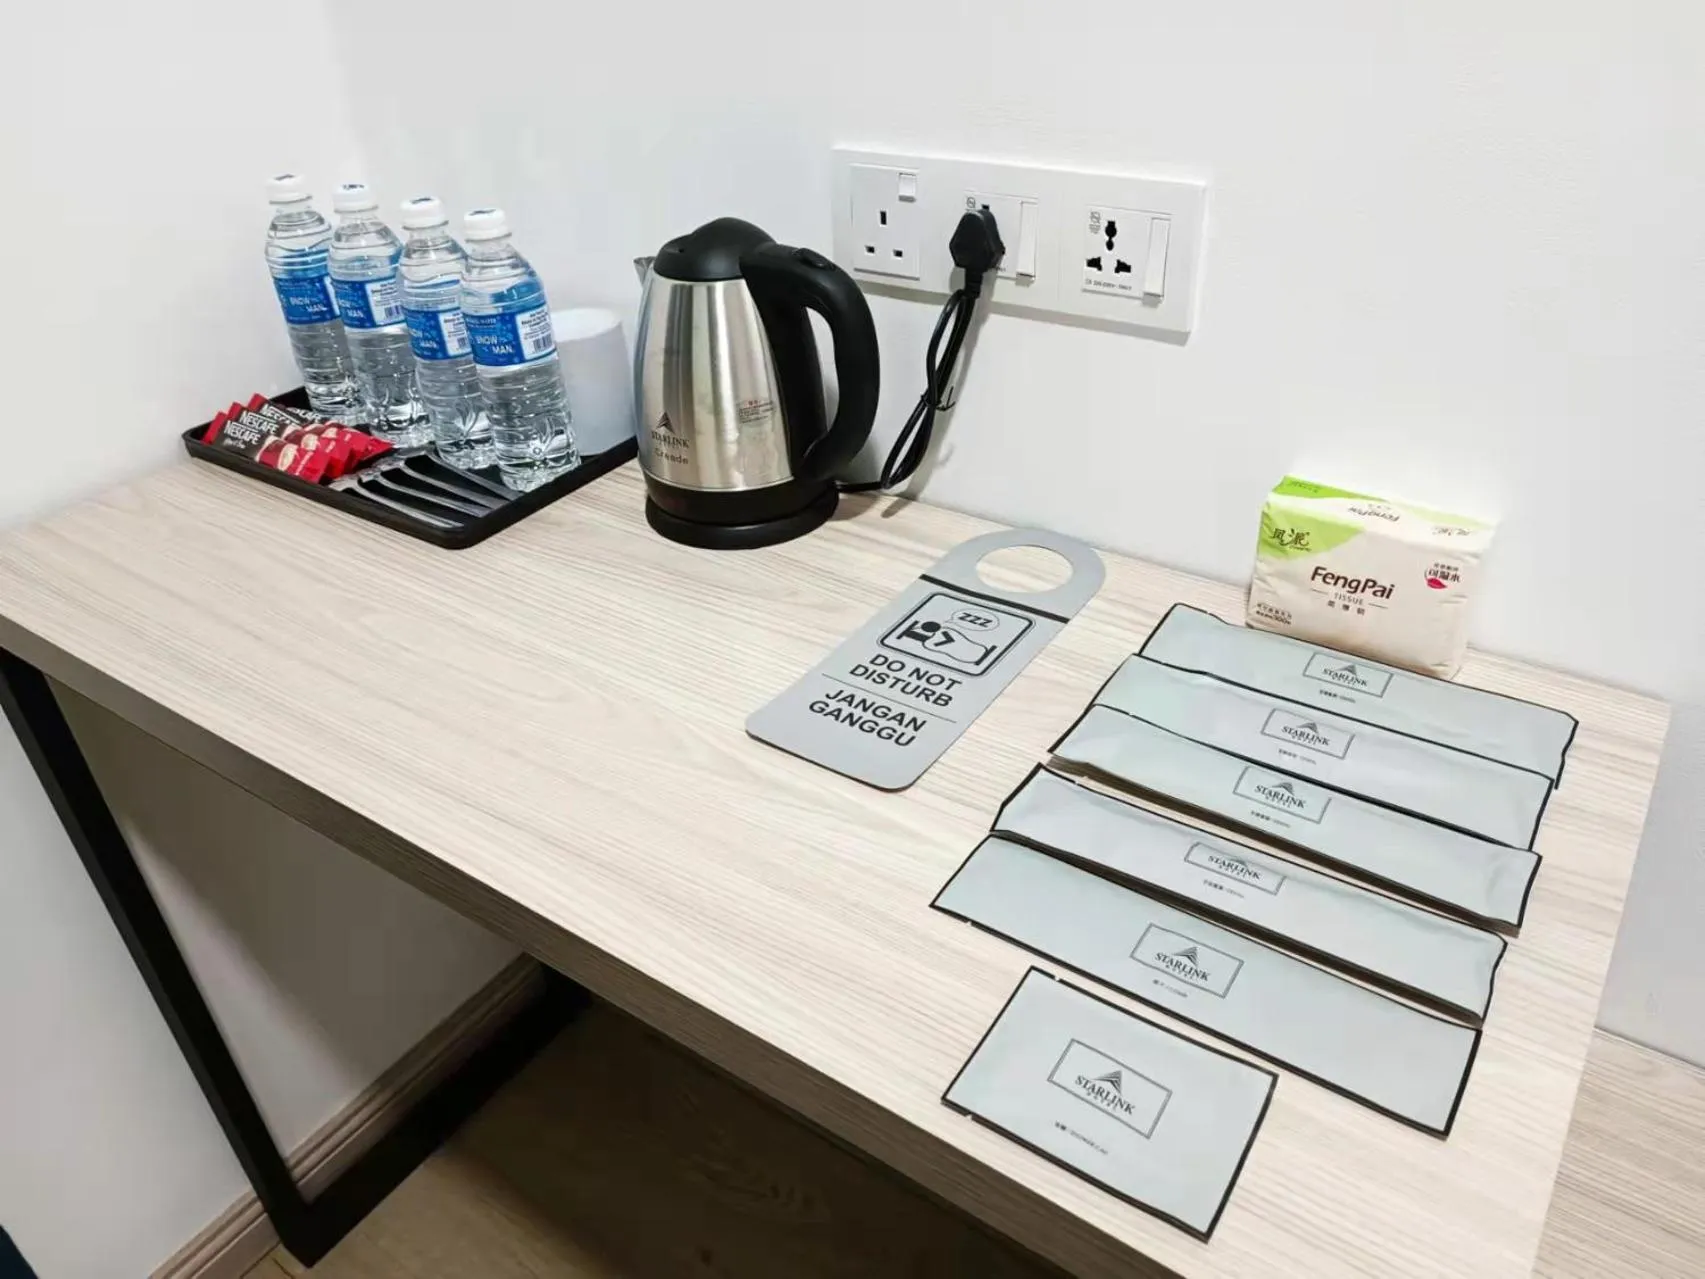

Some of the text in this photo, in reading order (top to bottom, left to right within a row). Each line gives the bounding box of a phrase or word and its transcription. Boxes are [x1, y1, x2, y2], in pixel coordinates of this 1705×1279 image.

[1311, 566, 1396, 600] FengPai
[1334, 592, 1364, 605] TISSUE
[849, 664, 953, 707] DISTURB
[869, 653, 962, 691] DO NOT
[1321, 667, 1368, 687] STARLINK
[808, 700, 916, 747] GANGGU
[825, 690, 926, 732] JANGAN
[1281, 725, 1331, 746] STARLINK
[1253, 784, 1307, 809] STARLINK
[1207, 855, 1261, 880] STARLINK
[1154, 952, 1211, 982] STARLINK
[1075, 1075, 1136, 1115] STARLINK
